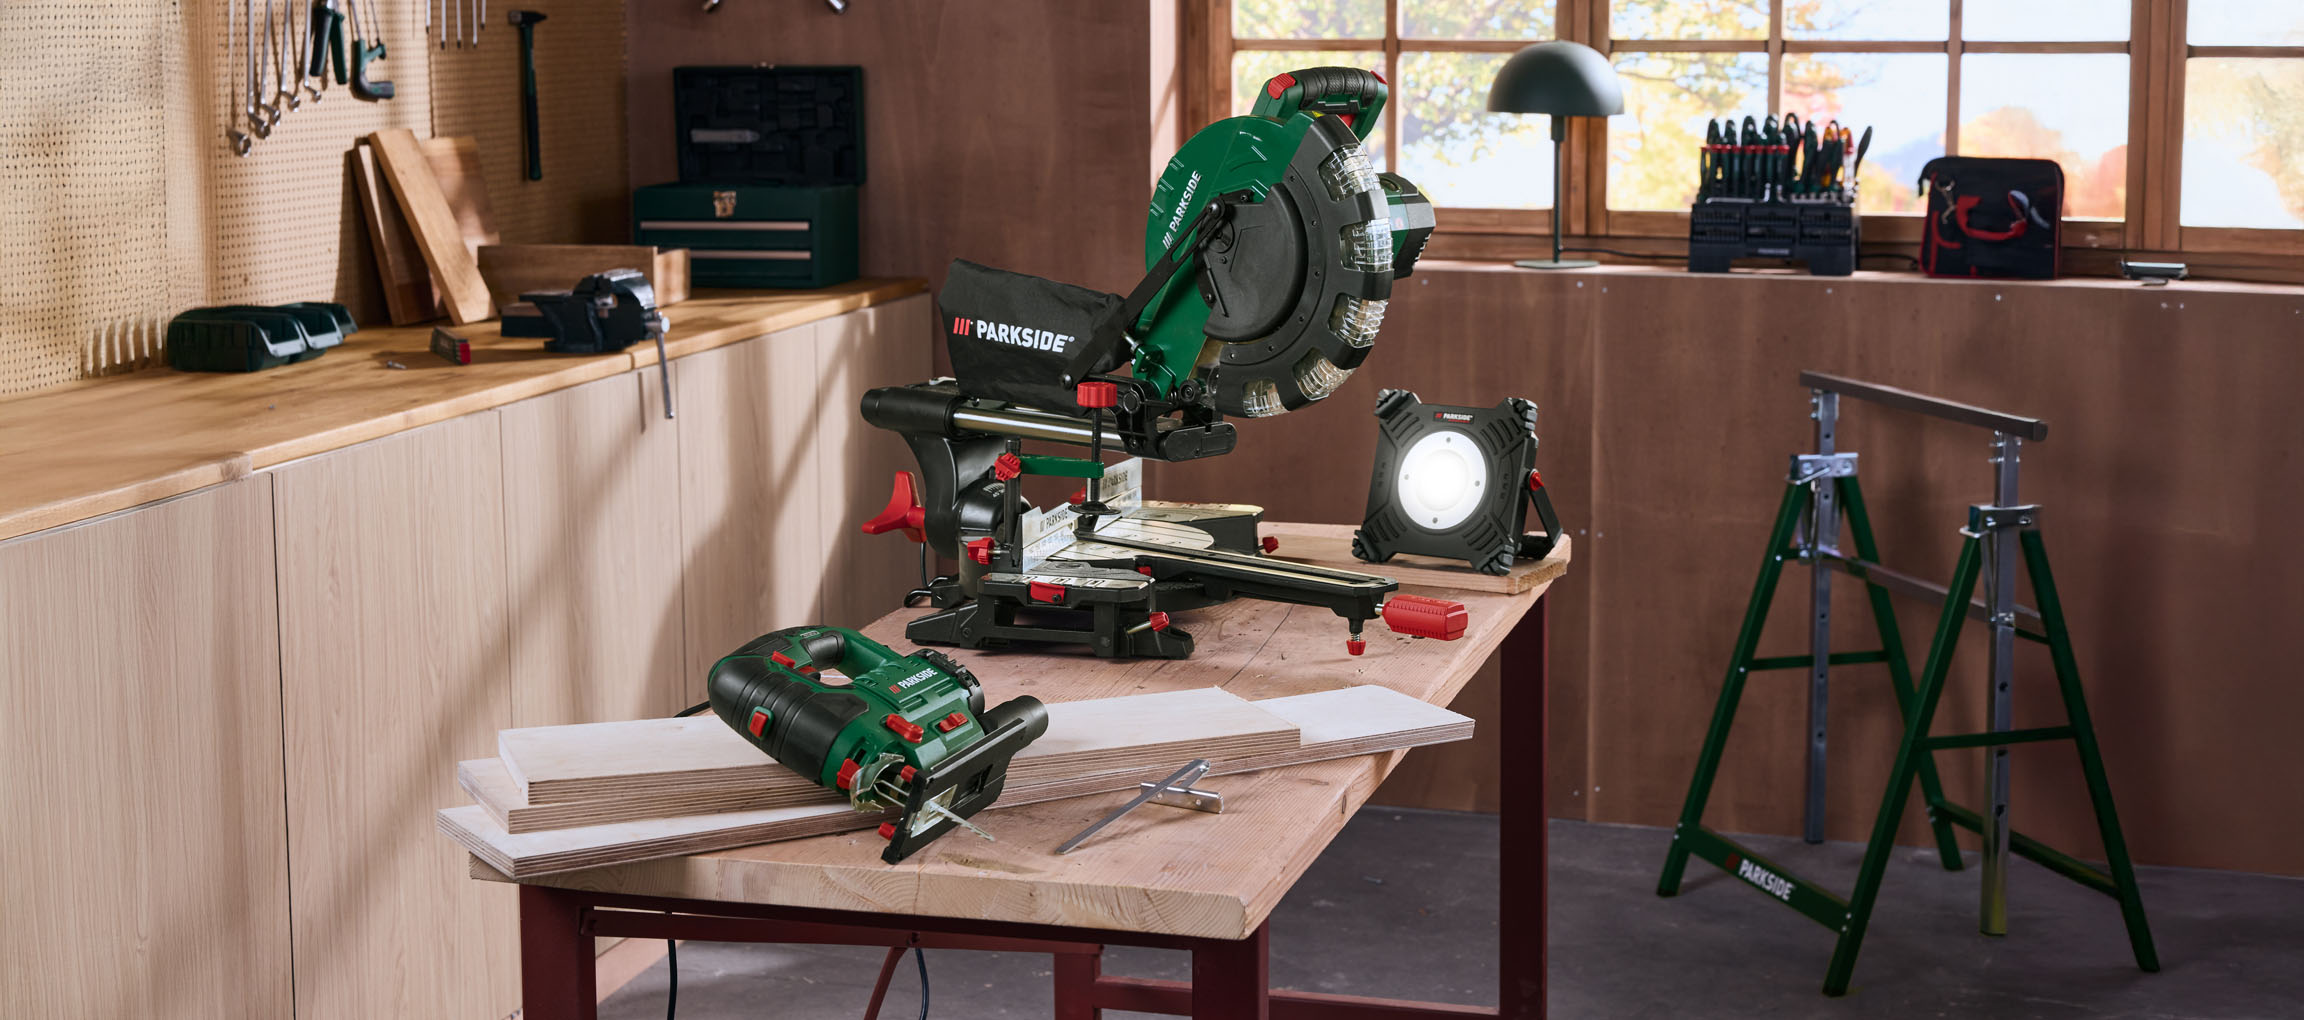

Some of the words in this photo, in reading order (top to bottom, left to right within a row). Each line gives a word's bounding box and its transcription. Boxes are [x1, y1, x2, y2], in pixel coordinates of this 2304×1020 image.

[1169, 170, 1202, 232] PARKSIDE
[1046, 507, 1068, 529] PARKSIDE
[897, 667, 938, 689] PARKSIDE
[1738, 858, 1795, 901] PARKSIDE
